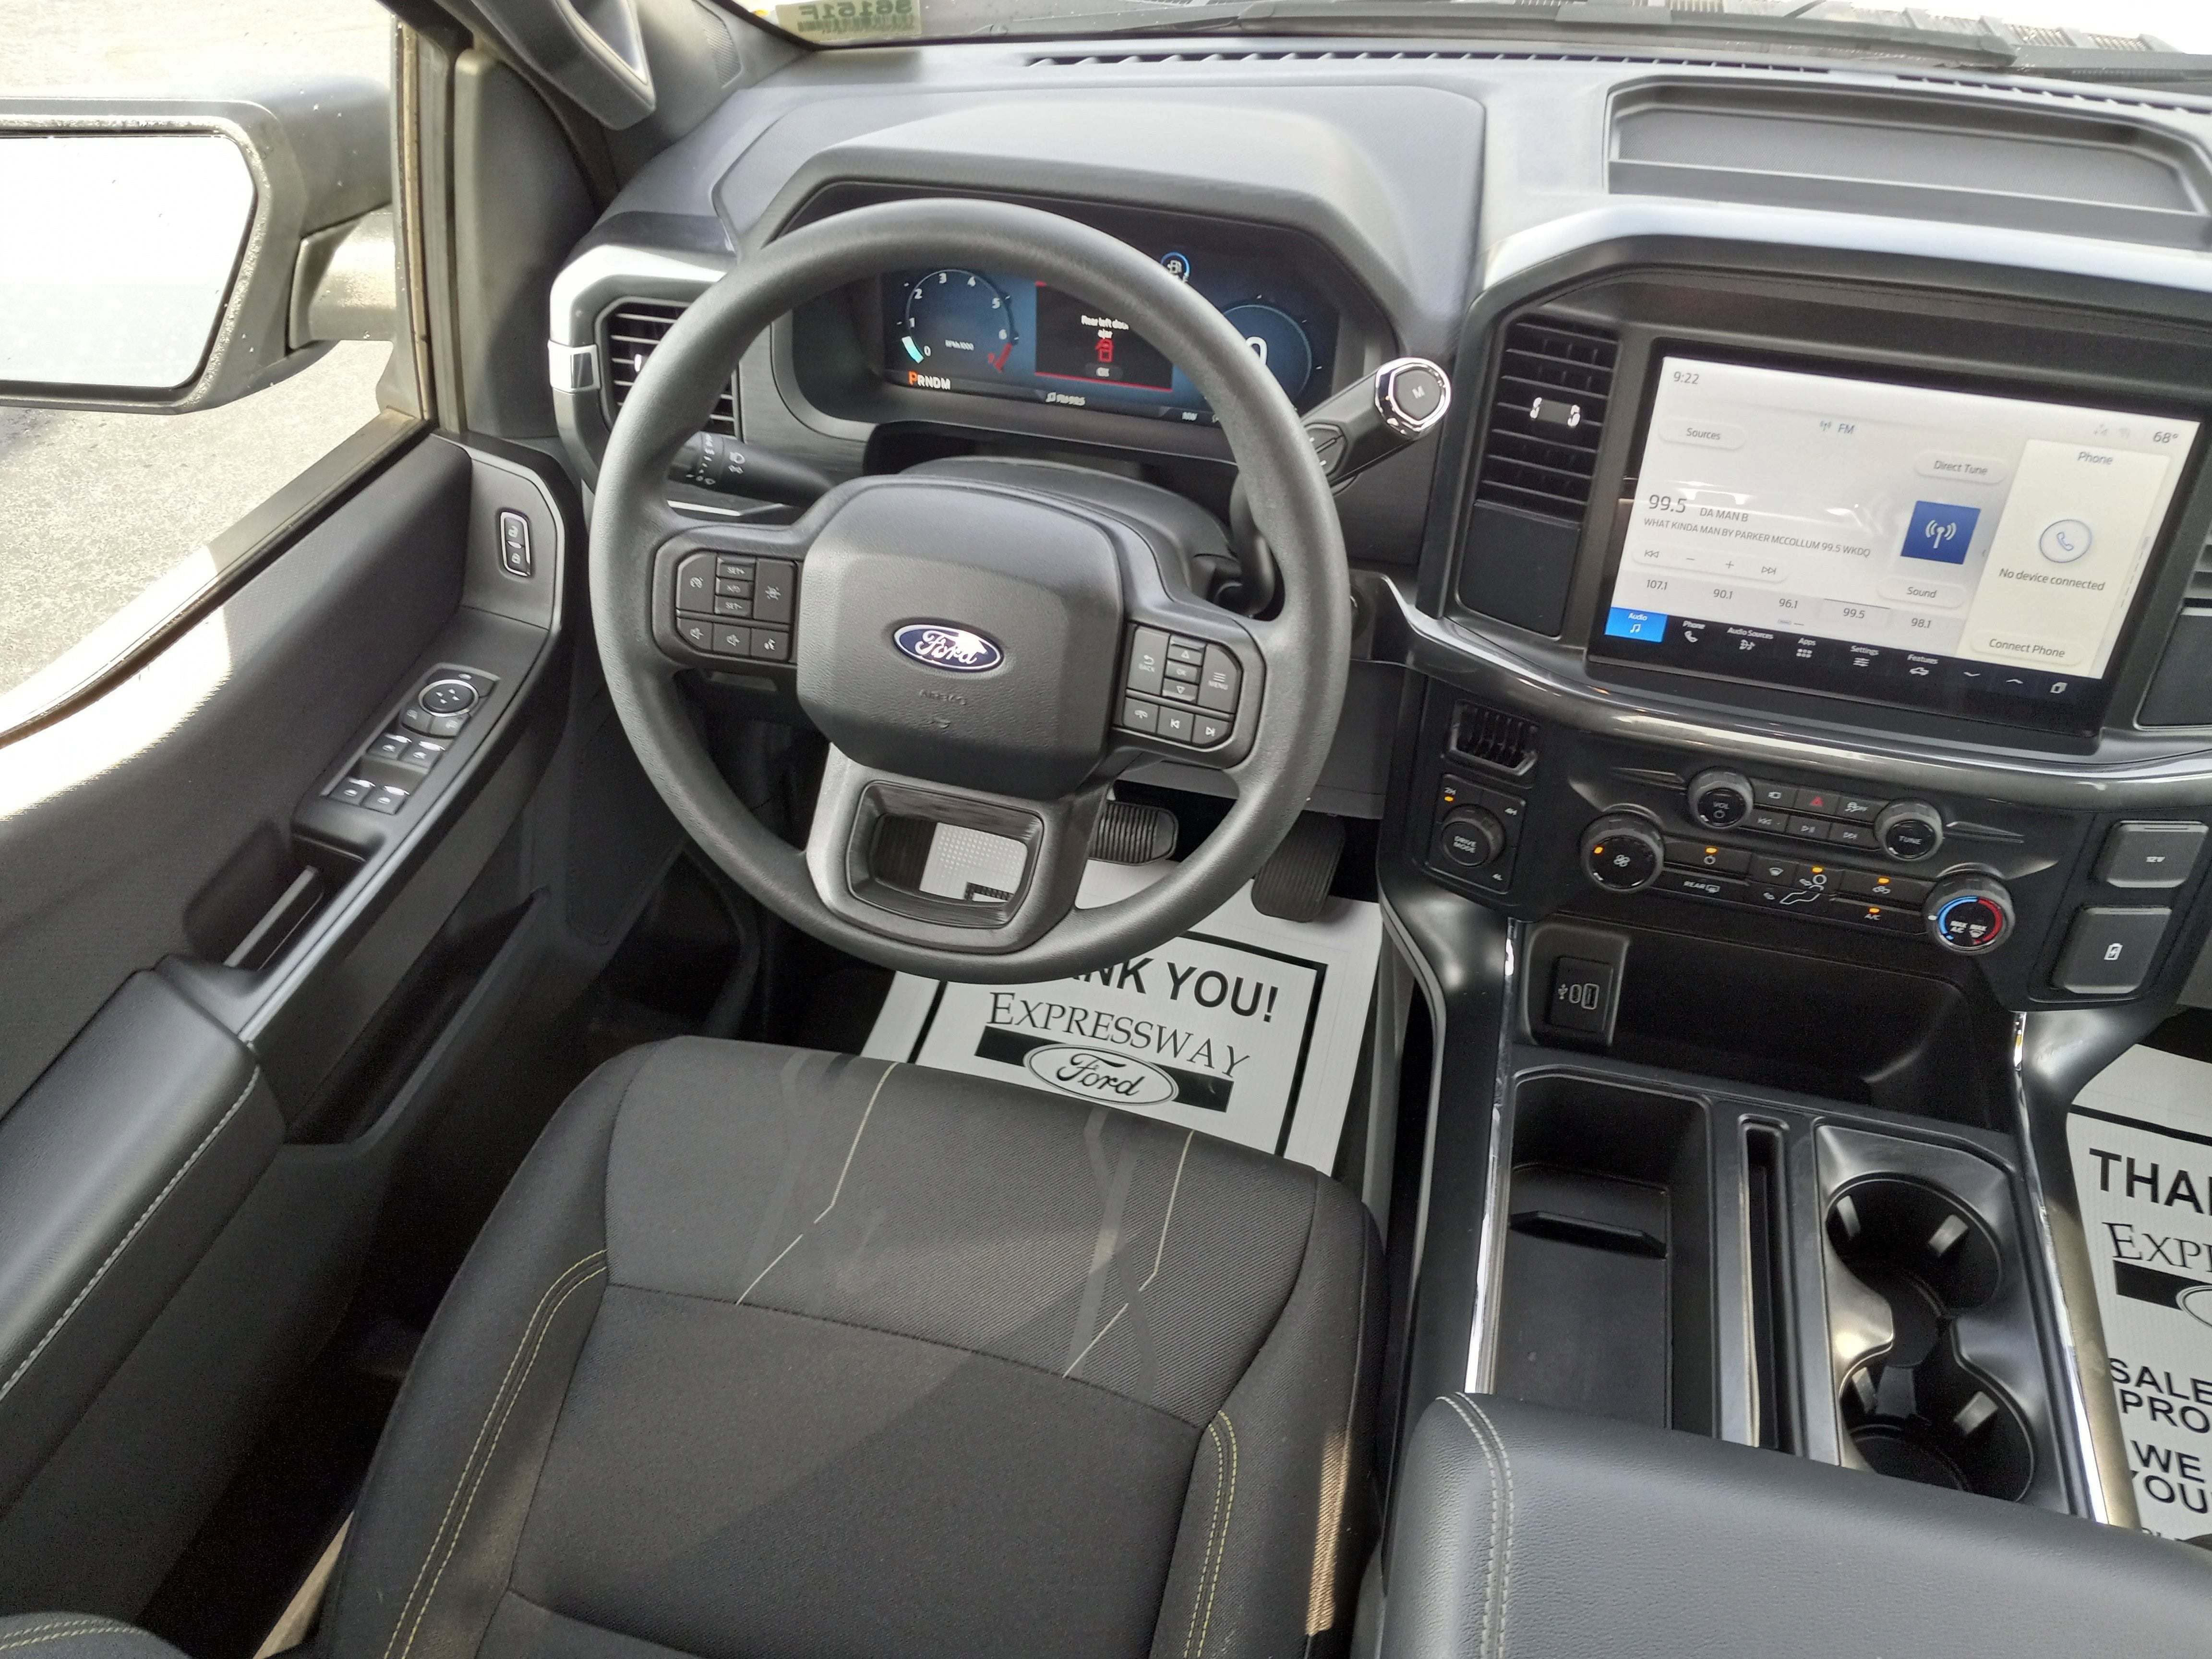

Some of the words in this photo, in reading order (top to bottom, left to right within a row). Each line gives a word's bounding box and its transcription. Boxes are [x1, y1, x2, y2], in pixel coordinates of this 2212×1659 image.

[939, 273, 947, 284] 3
[967, 276, 975, 287] 4
[914, 288, 923, 299] 2
[992, 298, 1000, 309] 5
[909, 317, 915, 328] 1
[924, 345, 931, 357] 0
[1674, 371, 1700, 385] 9:22
[1686, 428, 1721, 440] Sources
[1838, 424, 1855, 434] FM
[2078, 451, 2114, 465] Phone
[1934, 461, 1962, 473] Direct
[1965, 464, 1988, 475] Tune
[1648, 494, 1687, 513] 99.5
[1699, 507, 1714, 517] DA
[1715, 509, 1739, 521] MAN
[1741, 513, 1749, 522] B
[1644, 518, 1671, 529] WHAT
[1671, 521, 1698, 532] KINDA
[1699, 525, 1720, 535] MAN
[1721, 528, 1734, 537] BY
[1734, 530, 1770, 542] PARKER
[1770, 535, 1820, 550] MCCOLLUM
[1822, 542, 1841, 553] 99.5
[1647, 579, 1668, 590] 107.1
[1999, 568, 2014, 579] No
[2016, 571, 2049, 583] device
[2050, 577, 2105, 590] connected
[1713, 589, 1733, 600] 90.1
[1907, 587, 1937, 599] Sound
[1779, 598, 1798, 609] 96.1
[1628, 613, 1648, 621] Audio
[1843, 608, 1865, 619] 99.5
[1911, 617, 1931, 629] 98.1
[1727, 627, 1747, 636] Audio
[1747, 629, 1774, 640] Sources
[914, 630, 987, 664] Ford
[1798, 637, 1816, 647] Apps
[1989, 638, 2030, 653] Connect
[2032, 644, 2066, 658] Phone
[1850, 645, 1880, 656] Settings
[1167, 961, 1279, 1023] YOU!
[986, 991, 1250, 1079] EXPRESSWAY
[1056, 1052, 1146, 1096] Ford
[2089, 1147, 2212, 1216] THA
[2130, 1440, 2205, 1484] WE
